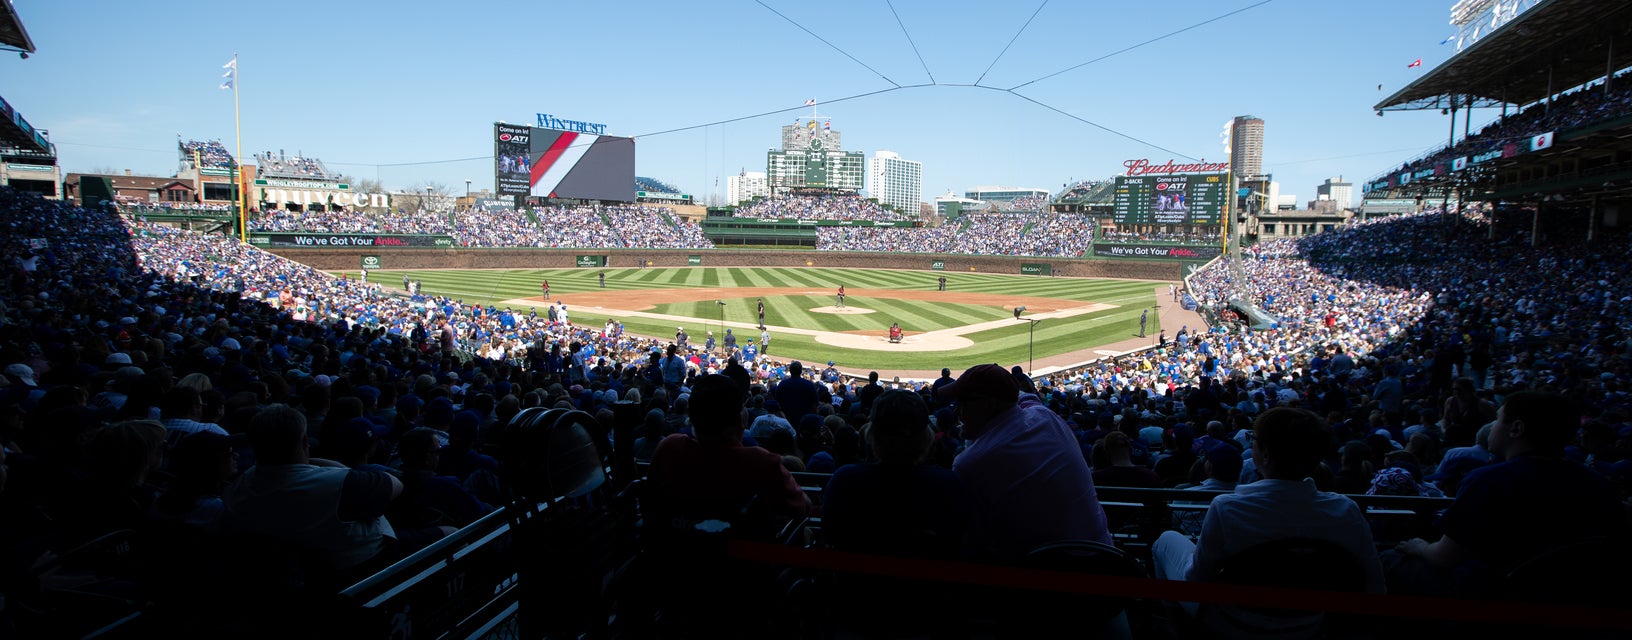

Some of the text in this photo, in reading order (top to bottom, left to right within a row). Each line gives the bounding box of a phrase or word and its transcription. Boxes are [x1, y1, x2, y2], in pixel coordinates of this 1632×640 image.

[1124, 159, 1229, 176] Budweiser
[265, 189, 390, 208] nuveen
[295, 236, 328, 245] We've
[330, 236, 348, 245] Got
[351, 236, 373, 245] Your
[1111, 246, 1133, 255] We've
[1135, 247, 1149, 255] Got
